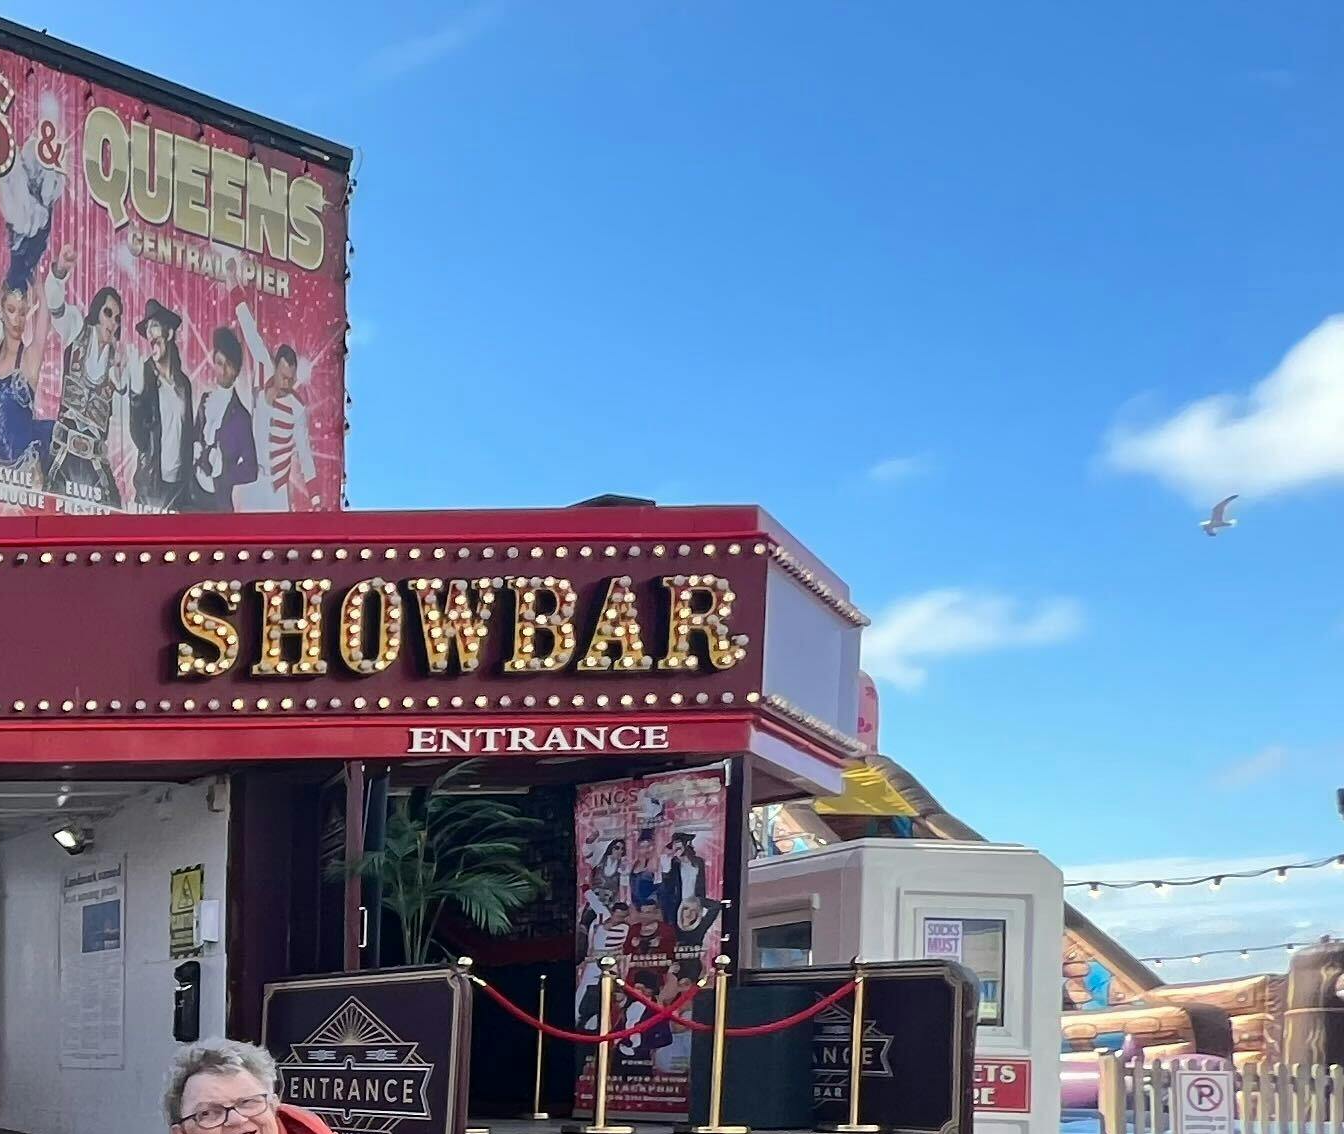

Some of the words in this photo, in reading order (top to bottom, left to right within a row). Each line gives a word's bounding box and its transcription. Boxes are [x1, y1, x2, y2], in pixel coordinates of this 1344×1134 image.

[37, 119, 64, 168] &
[83, 106, 325, 270] QUEENS
[128, 229, 229, 278] CENTRAL
[243, 257, 290, 298] PIER
[66, 480, 102, 502] ELVIS
[176, 574, 749, 677] SHOWBAR
[406, 724, 670, 753] ENTRANCE
[927, 923, 960, 936] SOCKS
[927, 937, 960, 953] MUST
[289, 1076, 414, 1104] ENTRANCE
